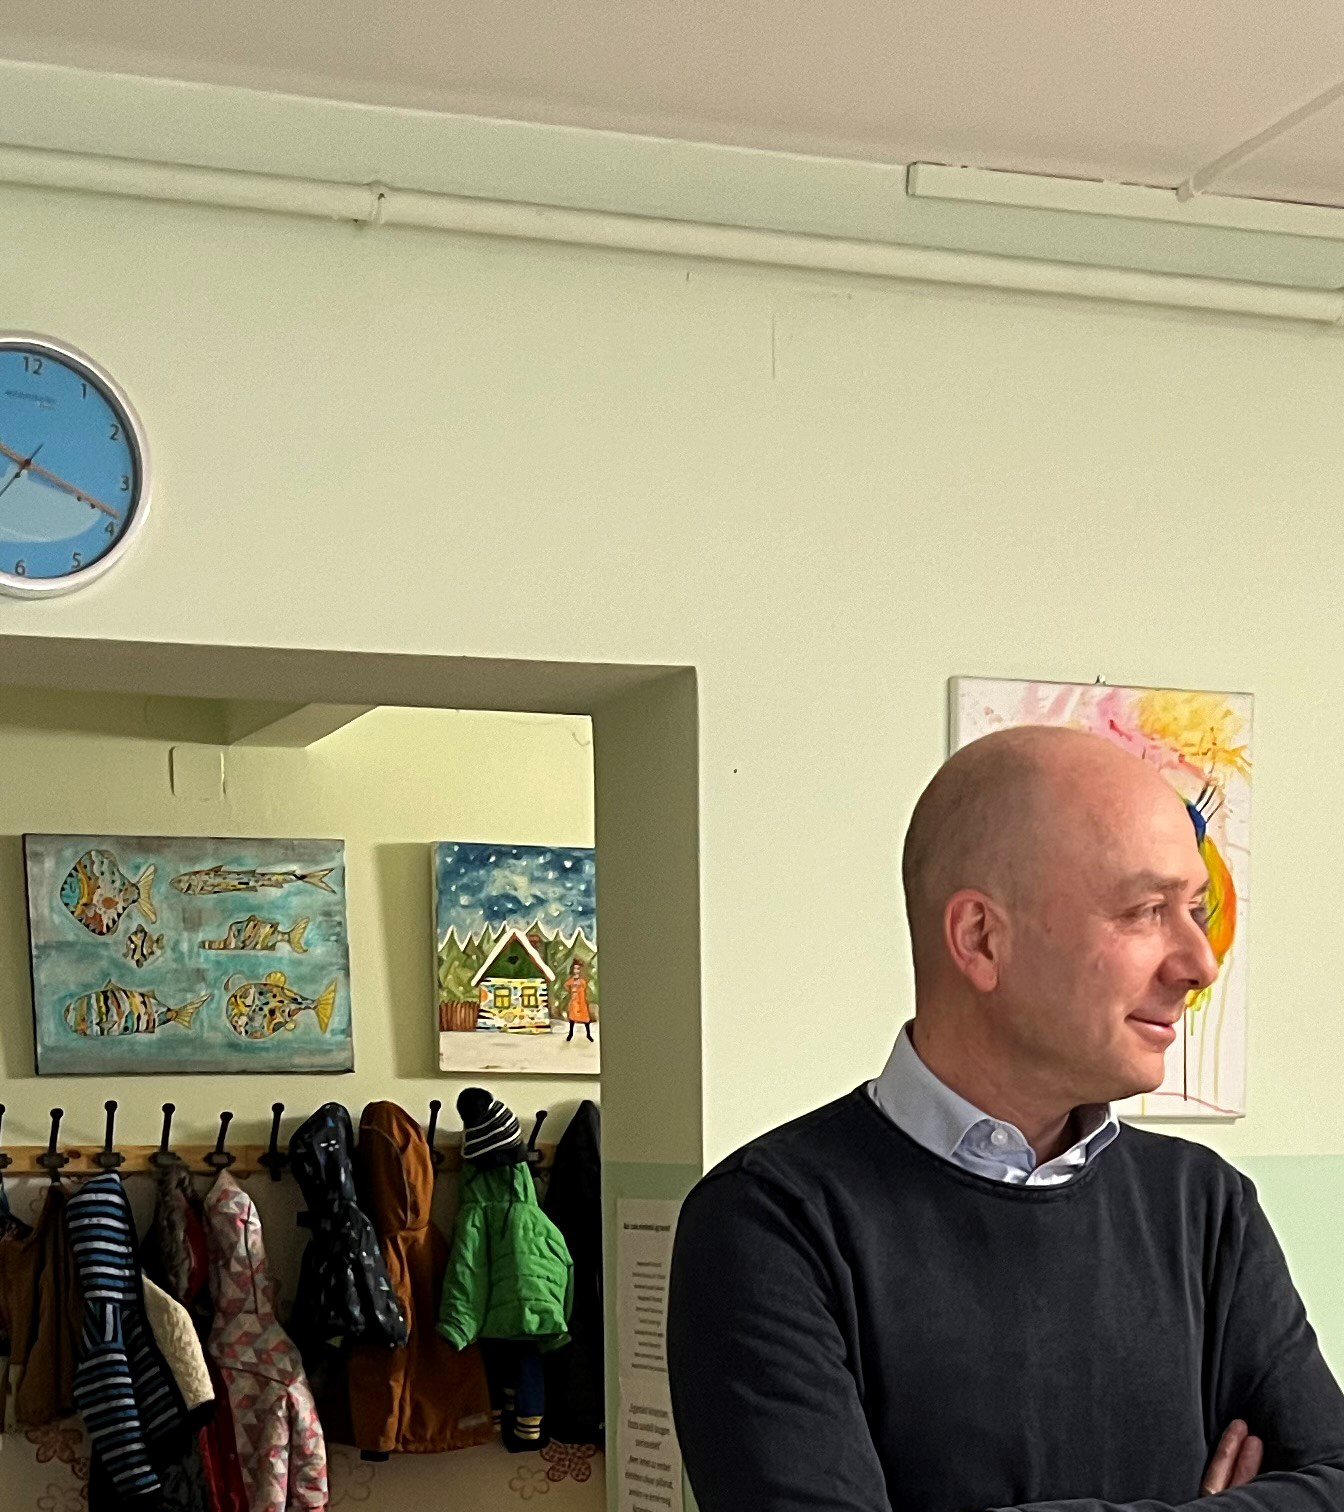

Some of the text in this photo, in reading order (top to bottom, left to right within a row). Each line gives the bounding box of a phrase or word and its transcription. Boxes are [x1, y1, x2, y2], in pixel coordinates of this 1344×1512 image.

[22, 355, 44, 375] 12
[80, 382, 87, 400] 1
[109, 423, 119, 441] 2
[120, 475, 130, 492] 3
[104, 520, 115, 536] 4
[14, 559, 26, 576] 6
[72, 552, 82, 570] 5
